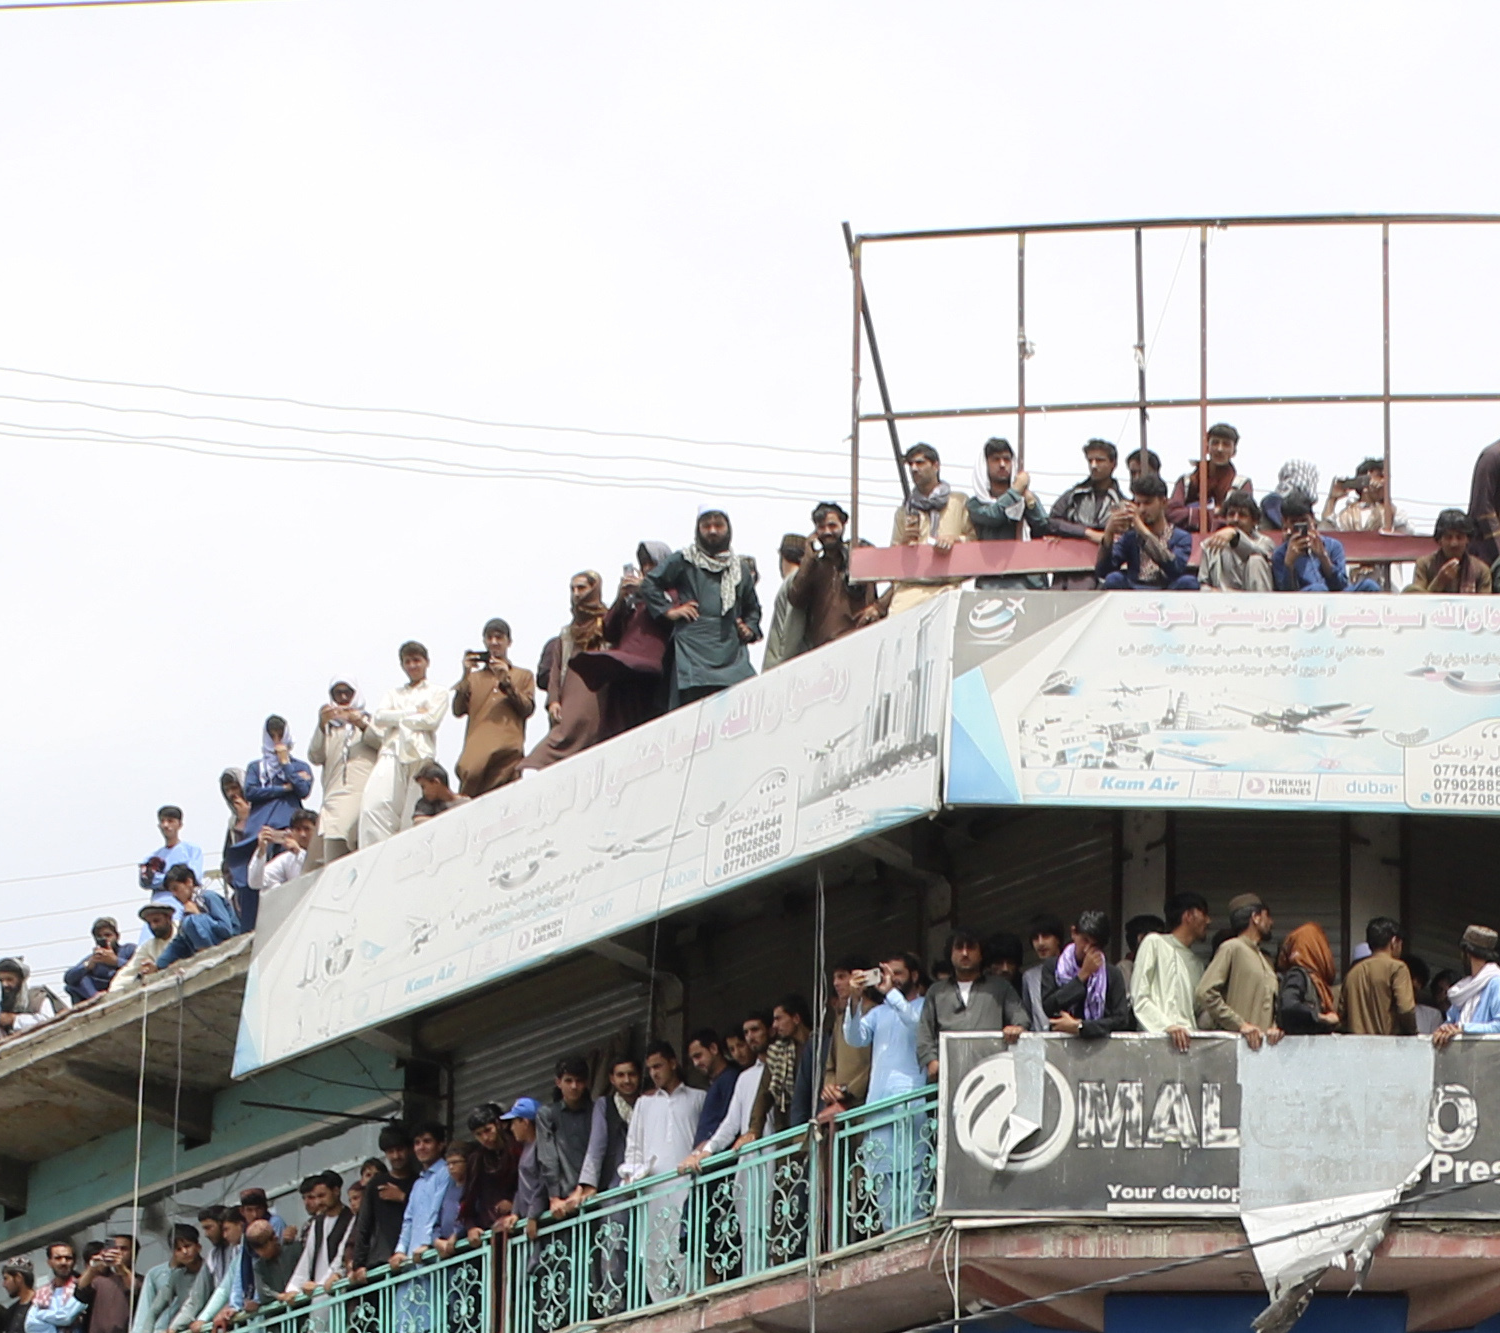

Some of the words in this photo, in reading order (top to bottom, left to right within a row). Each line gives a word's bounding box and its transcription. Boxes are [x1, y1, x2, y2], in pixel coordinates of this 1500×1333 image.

[1303, 604, 1324, 630] او
[1101, 775, 1144, 791] Kam
[1148, 775, 1179, 791] Air
[1268, 778, 1312, 788] TURKISH
[1267, 787, 1312, 796] AIRLINES
[1106, 1183, 1156, 1200] Your
